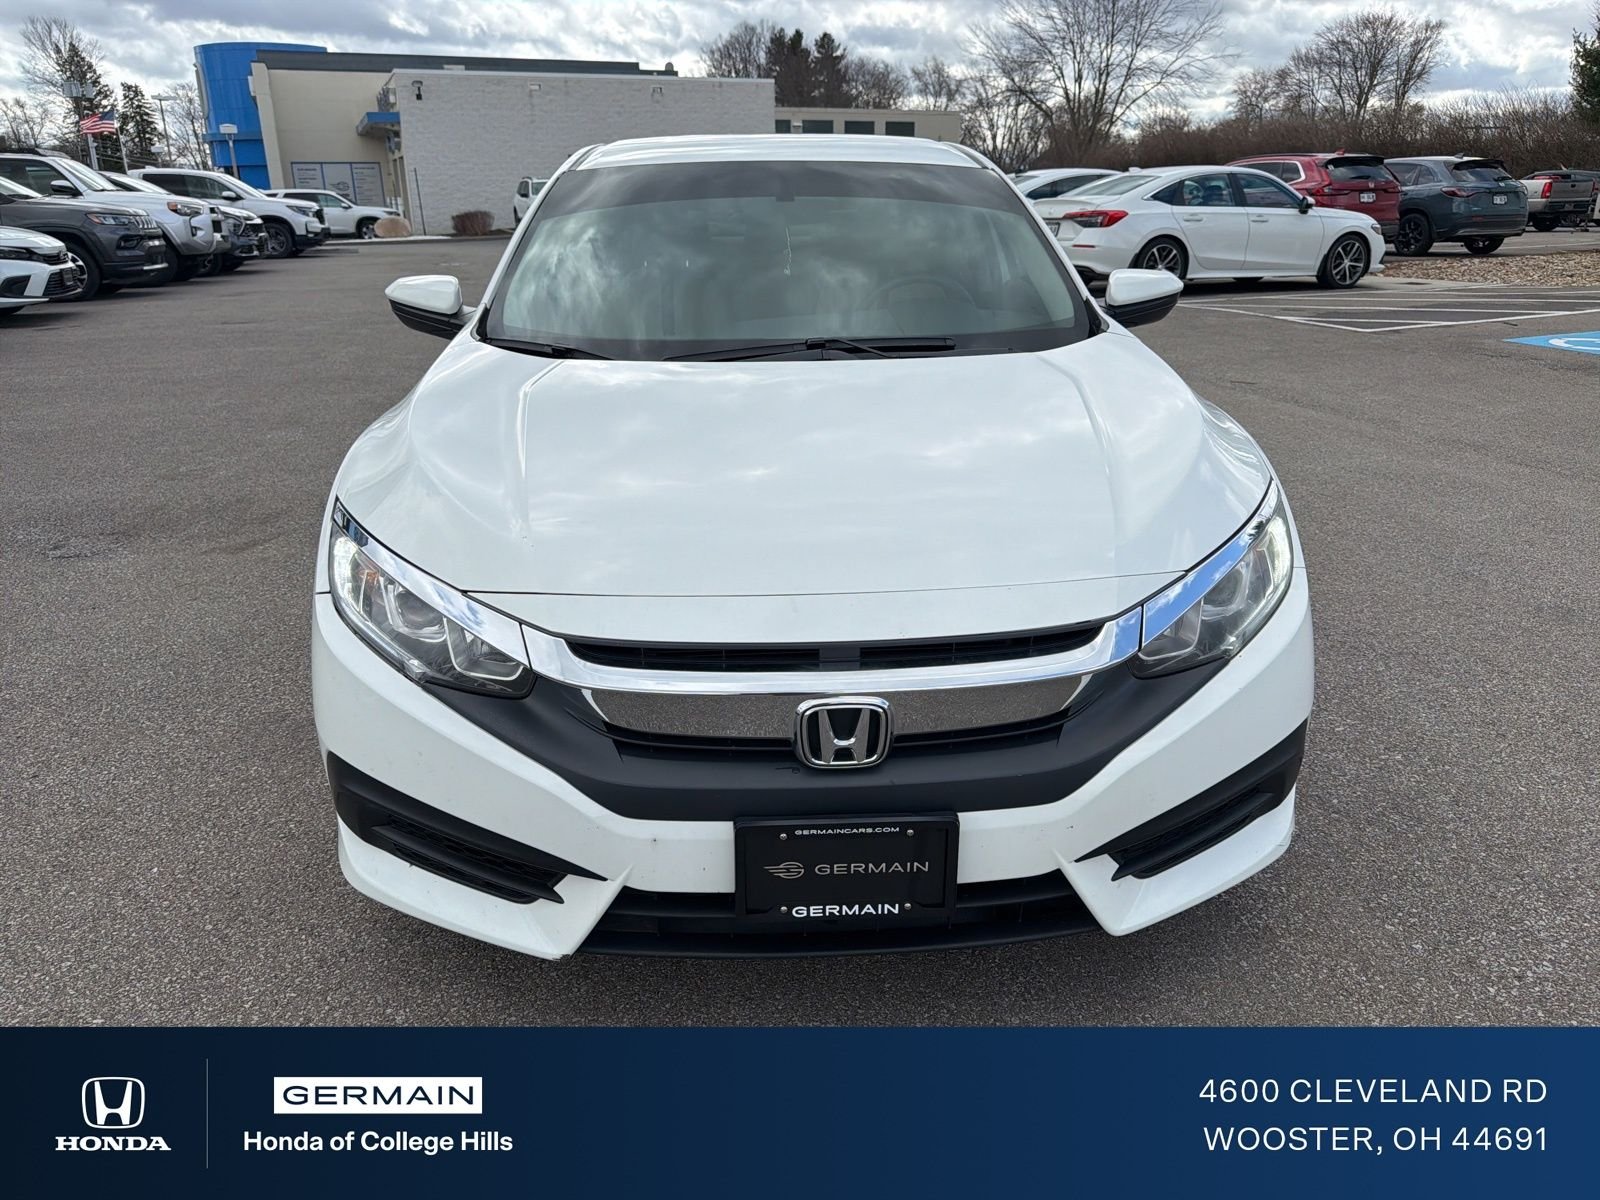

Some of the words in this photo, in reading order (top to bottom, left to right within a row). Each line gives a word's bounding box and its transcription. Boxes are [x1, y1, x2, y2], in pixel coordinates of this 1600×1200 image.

[794, 826, 900, 836] GERMAINCARS.COM
[814, 861, 930, 876] GERMAIN
[791, 903, 900, 918] GERMAIN
